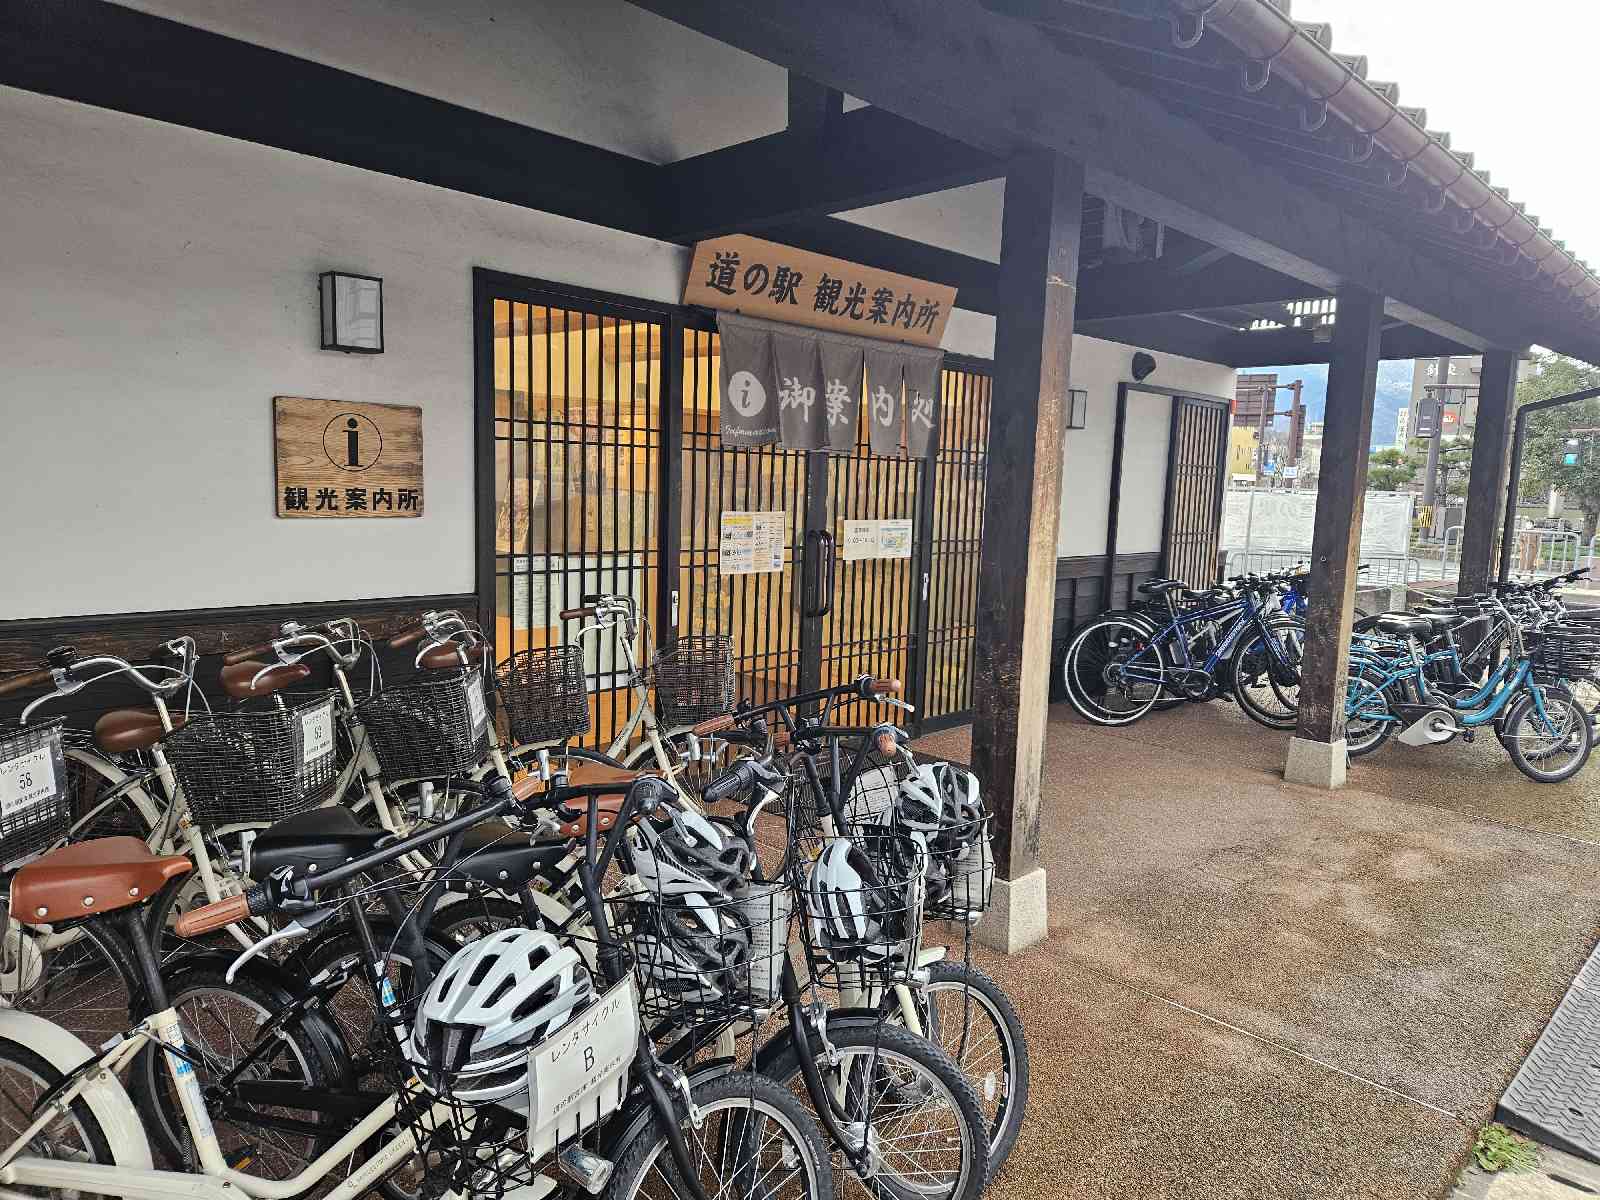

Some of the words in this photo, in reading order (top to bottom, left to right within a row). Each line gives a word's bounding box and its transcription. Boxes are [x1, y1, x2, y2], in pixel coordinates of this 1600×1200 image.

[705, 251, 803, 305] 道の駅
[813, 272, 940, 334] 観光案内所
[778, 376, 936, 429] 御案内処
[284, 486, 419, 511] 観光案内所
[19, 772, 33, 790] 58
[551, 999, 621, 1063] レンタサイクル
[583, 1046, 596, 1072] B
